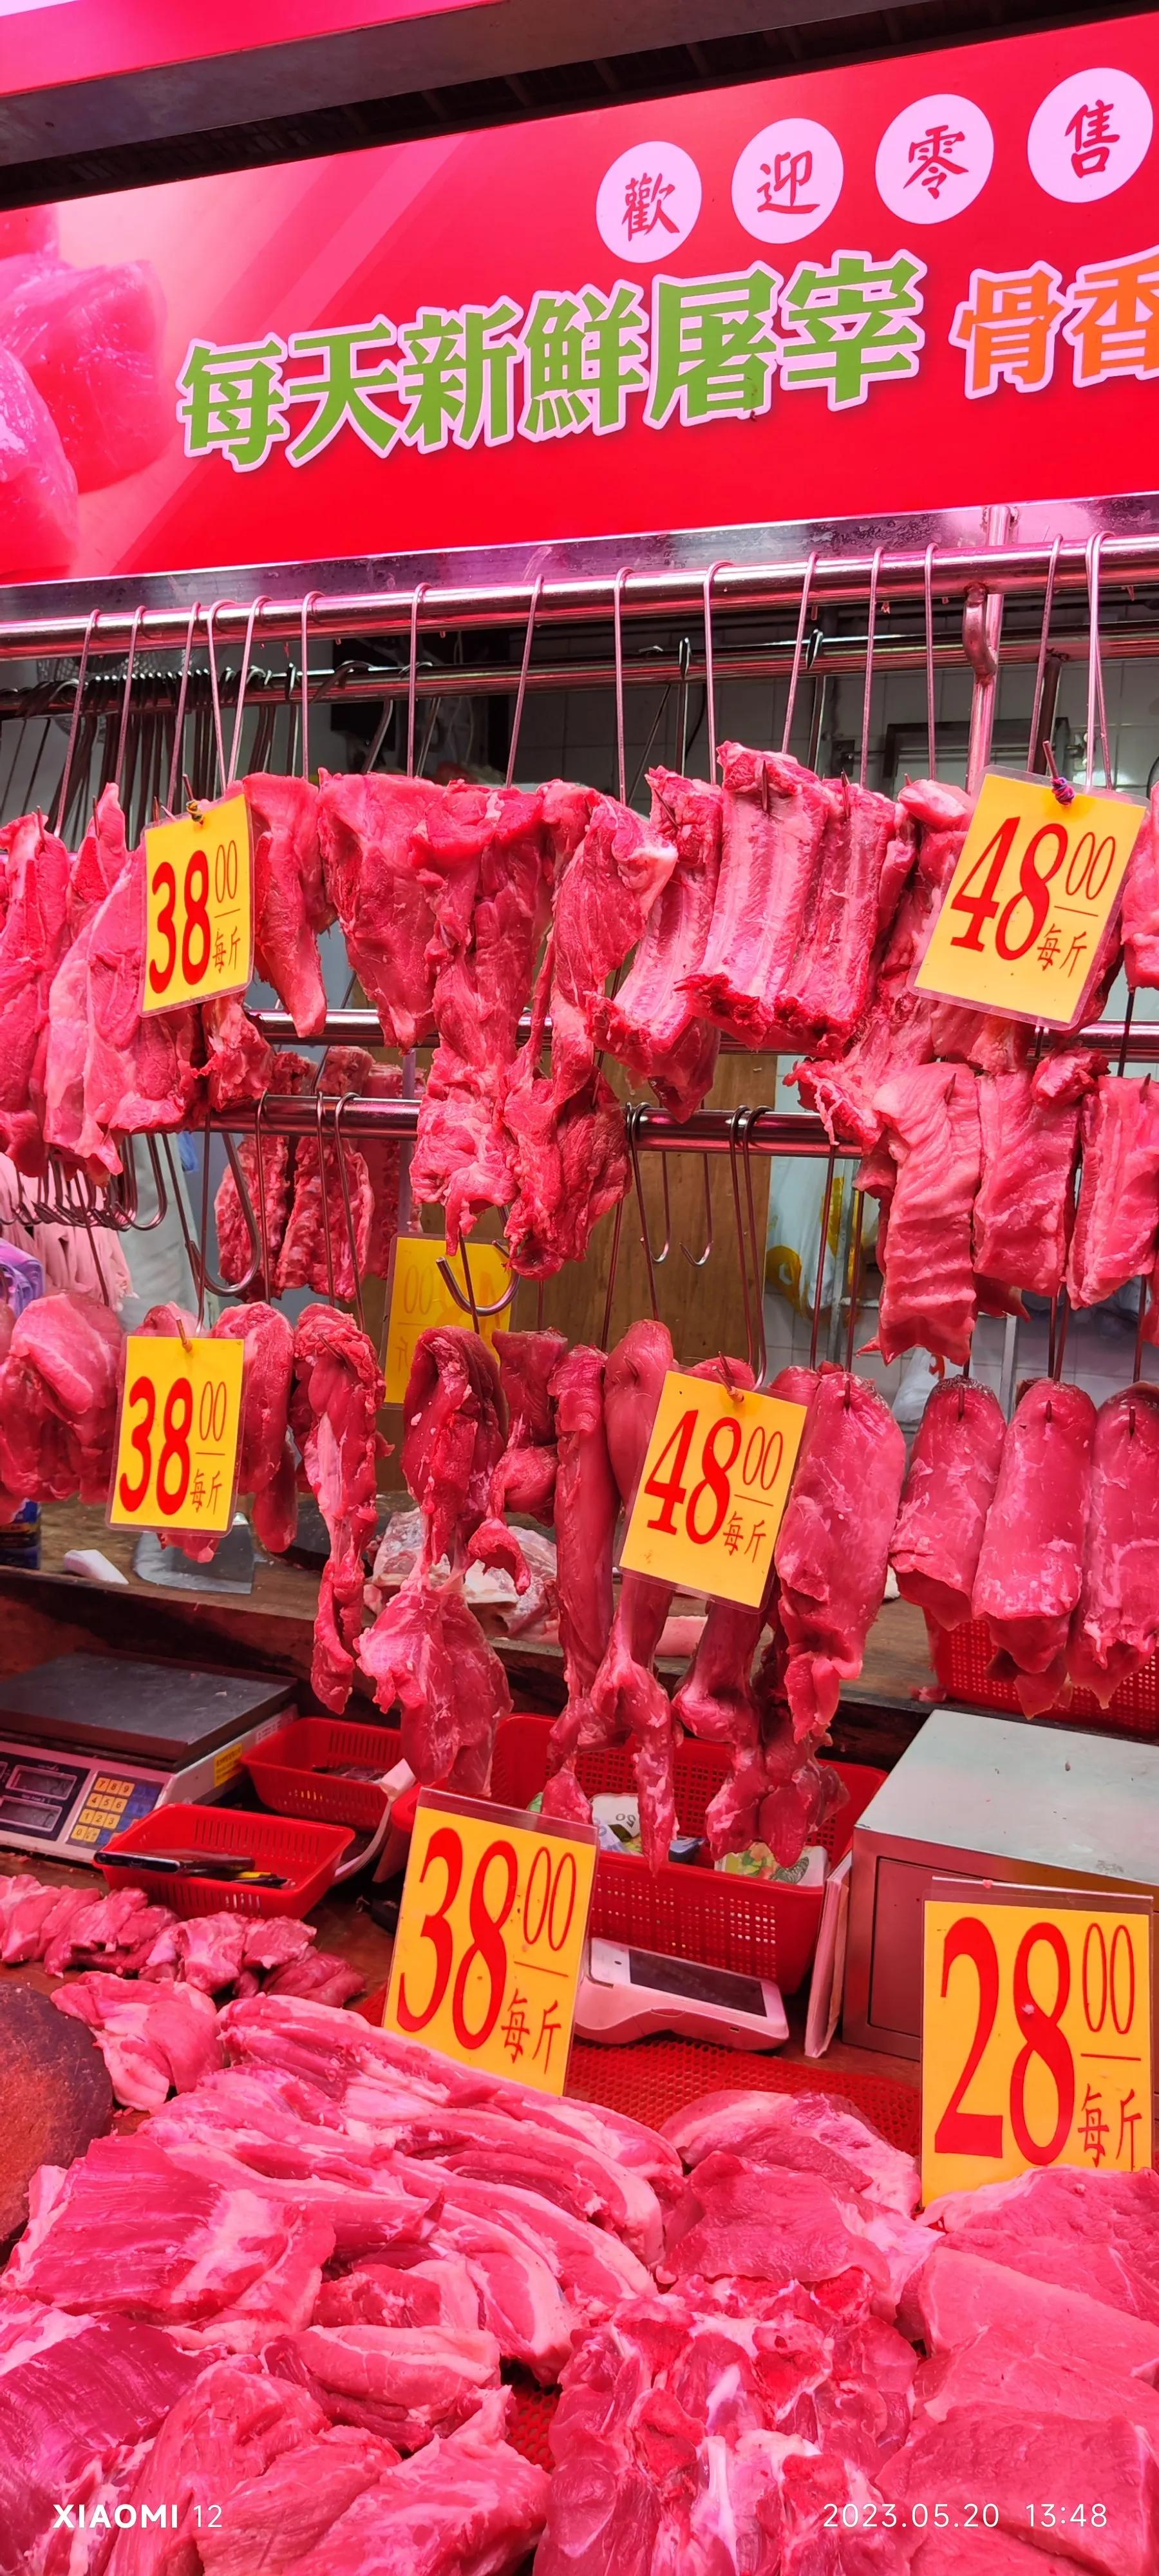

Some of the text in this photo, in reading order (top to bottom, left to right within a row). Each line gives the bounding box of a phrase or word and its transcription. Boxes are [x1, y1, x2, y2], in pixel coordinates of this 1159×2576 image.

[621, 99, 1120, 243] 歡迎零售
[179, 252, 923, 468] 每天新鮮屠宰
[149, 850, 211, 994] 38
[212, 926, 240, 974] 每斤
[950, 816, 1068, 960] 48
[1037, 923, 1088, 978] 每斤
[120, 1376, 193, 1515] 38
[190, 1468, 223, 1515] 每斤
[644, 1409, 742, 1544] 48
[723, 1511, 766, 1563] 每斤
[397, 1827, 518, 2050] 38
[501, 1988, 561, 2074] 每斤
[934, 1917, 1075, 2166] 28
[1077, 2083, 1142, 2172] 每斤
